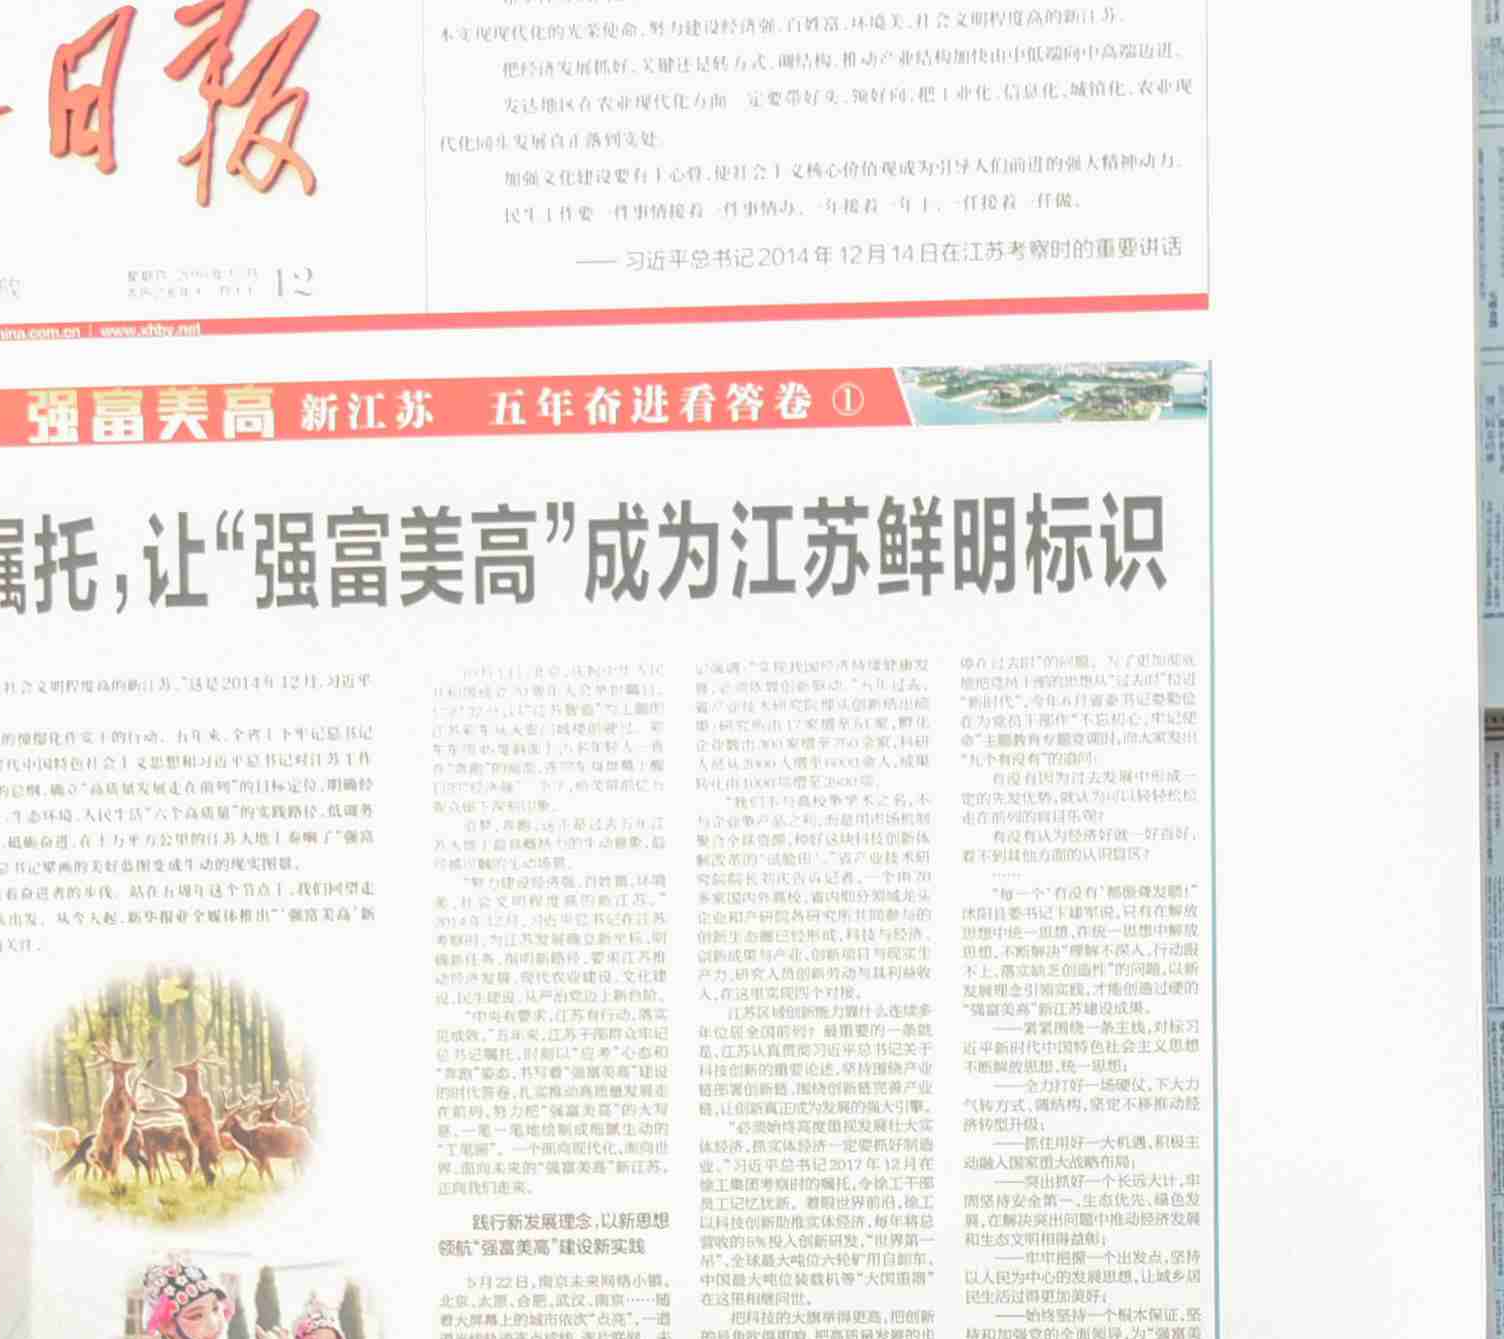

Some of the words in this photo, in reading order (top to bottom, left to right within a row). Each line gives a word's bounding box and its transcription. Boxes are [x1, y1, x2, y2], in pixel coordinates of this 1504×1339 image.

[25, 388, 276, 443] 强富美高
[299, 390, 434, 432] 新江苏
[488, 382, 813, 427] 五年奋进看答卷
